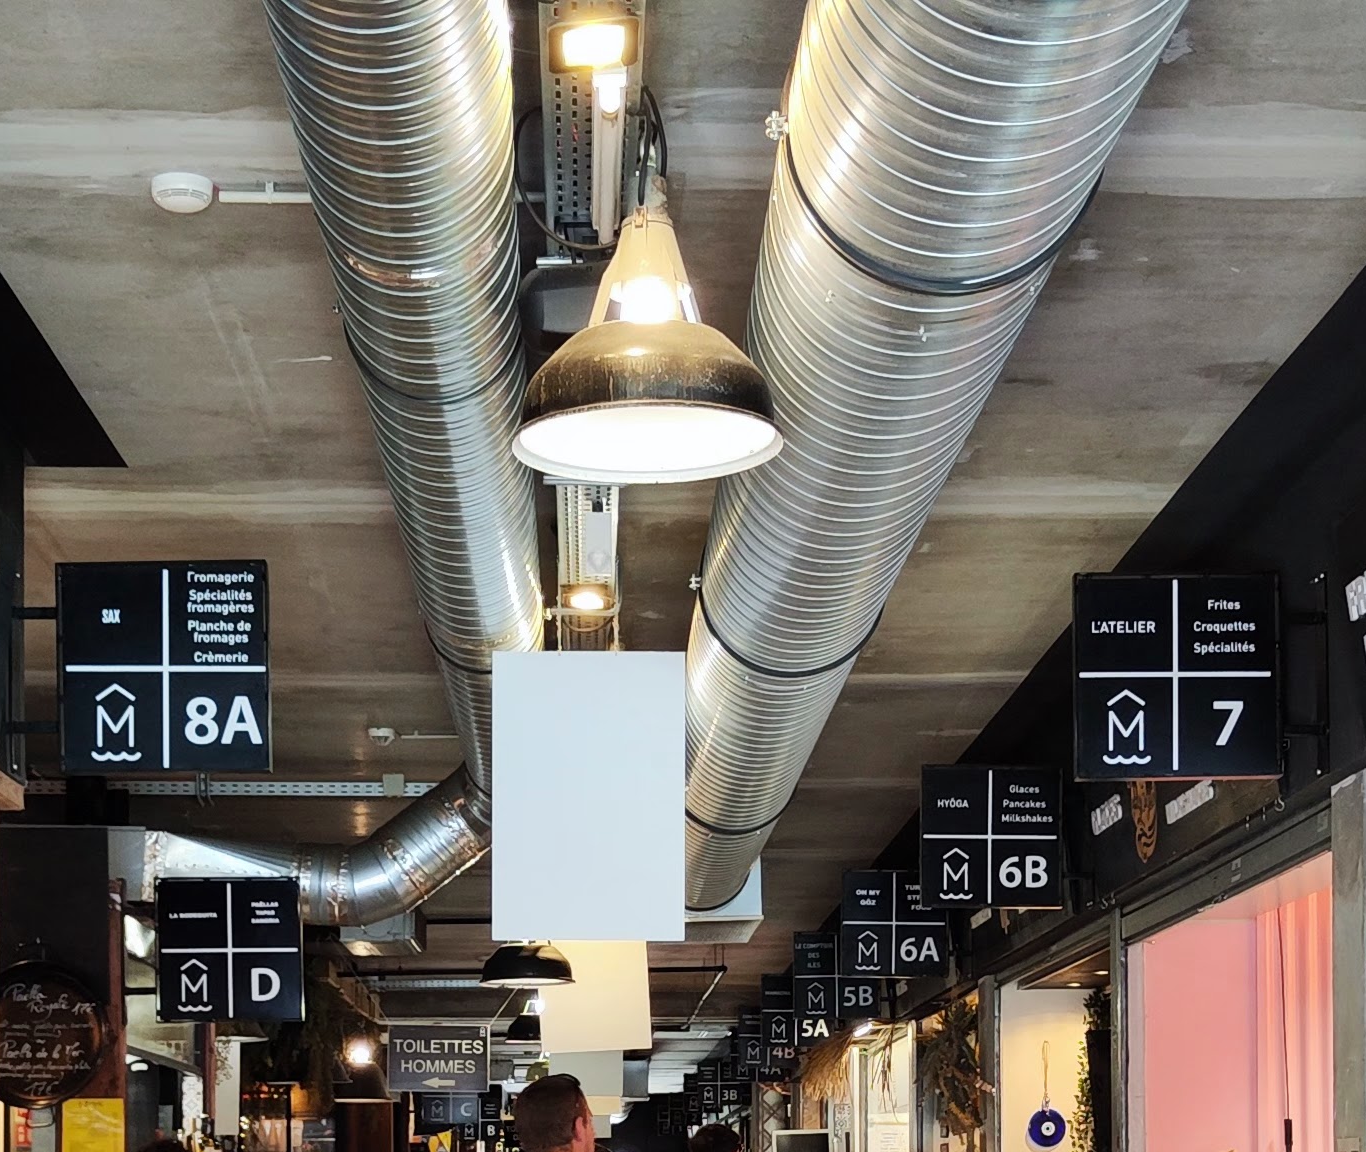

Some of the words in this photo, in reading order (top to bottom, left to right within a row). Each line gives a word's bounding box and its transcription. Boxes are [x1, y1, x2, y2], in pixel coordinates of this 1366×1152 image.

[187, 571, 254, 585] Fromagerie
[188, 589, 253, 604] Spécialités
[187, 600, 254, 616] fromagères
[1208, 599, 1241, 611] Frites
[101, 609, 121, 624] SAX
[188, 619, 235, 633] Planche
[236, 619, 252, 632] de
[1091, 620, 1156, 635] L'ATELIER
[1193, 620, 1256, 635] Croquettes
[193, 631, 249, 645] fromages
[1193, 641, 1256, 655] Spécialités
[193, 650, 249, 664] Crèmerie
[184, 696, 263, 746] 8A
[1212, 700, 1245, 747] 7
[1009, 784, 1040, 794] Glaces
[1002, 799, 1047, 809] Pancakes
[1001, 813, 1054, 823] Milkshakes
[998, 855, 1049, 890] 6B
[899, 936, 940, 962] 6A
[251, 967, 281, 1002] D
[843, 985, 874, 1007] 5B
[801, 1018, 830, 1038] 5A
[393, 1039, 484, 1054] TOILETTES
[401, 1059, 476, 1074] HOMMES
[721, 1089, 738, 1101] 3B
[460, 1102, 473, 1117] C
[487, 1125, 496, 1137] B
